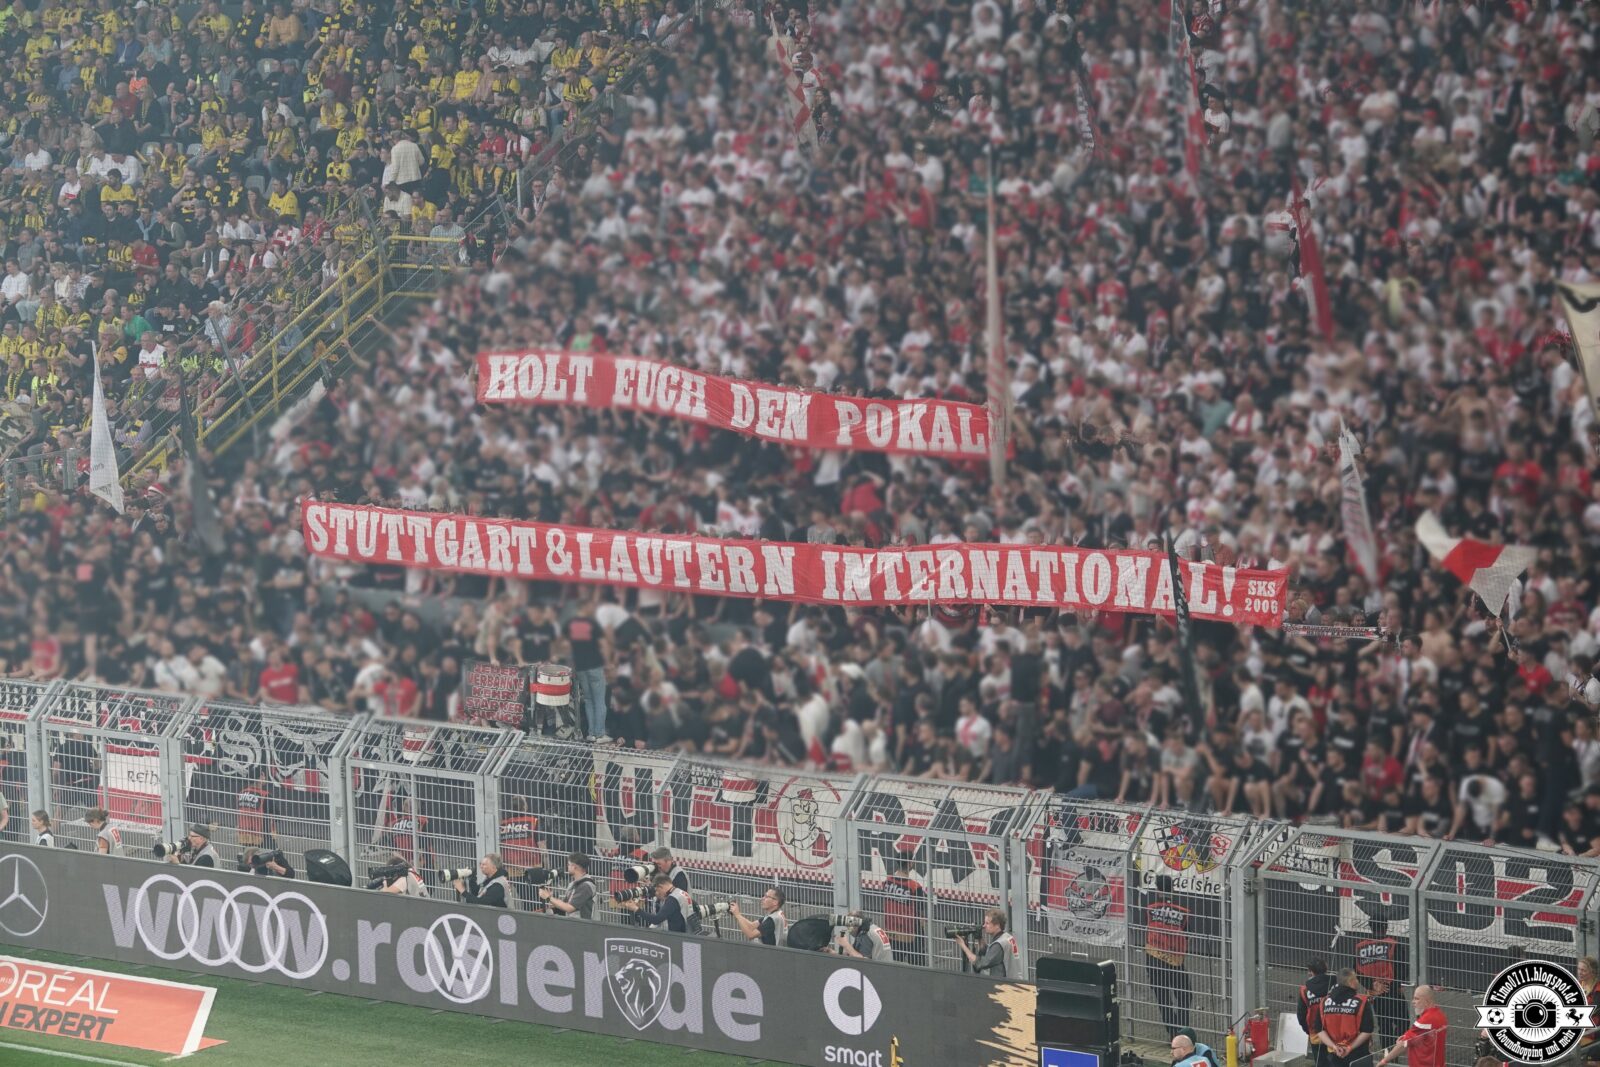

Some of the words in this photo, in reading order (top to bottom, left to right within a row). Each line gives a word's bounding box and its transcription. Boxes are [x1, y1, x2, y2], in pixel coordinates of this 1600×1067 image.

[485, 353, 593, 400] HOLT
[612, 358, 708, 418] EUCH
[730, 383, 812, 440] DEN
[835, 399, 986, 453] POKAL
[821, 549, 1236, 617] INTERNATIONAL!
[1248, 580, 1277, 597] SKS
[1244, 598, 1278, 614] 2006
[610, 944, 665, 959] PEUGEOT
[8, 1003, 115, 1041] EXPERT
[824, 1045, 882, 1067] smart
